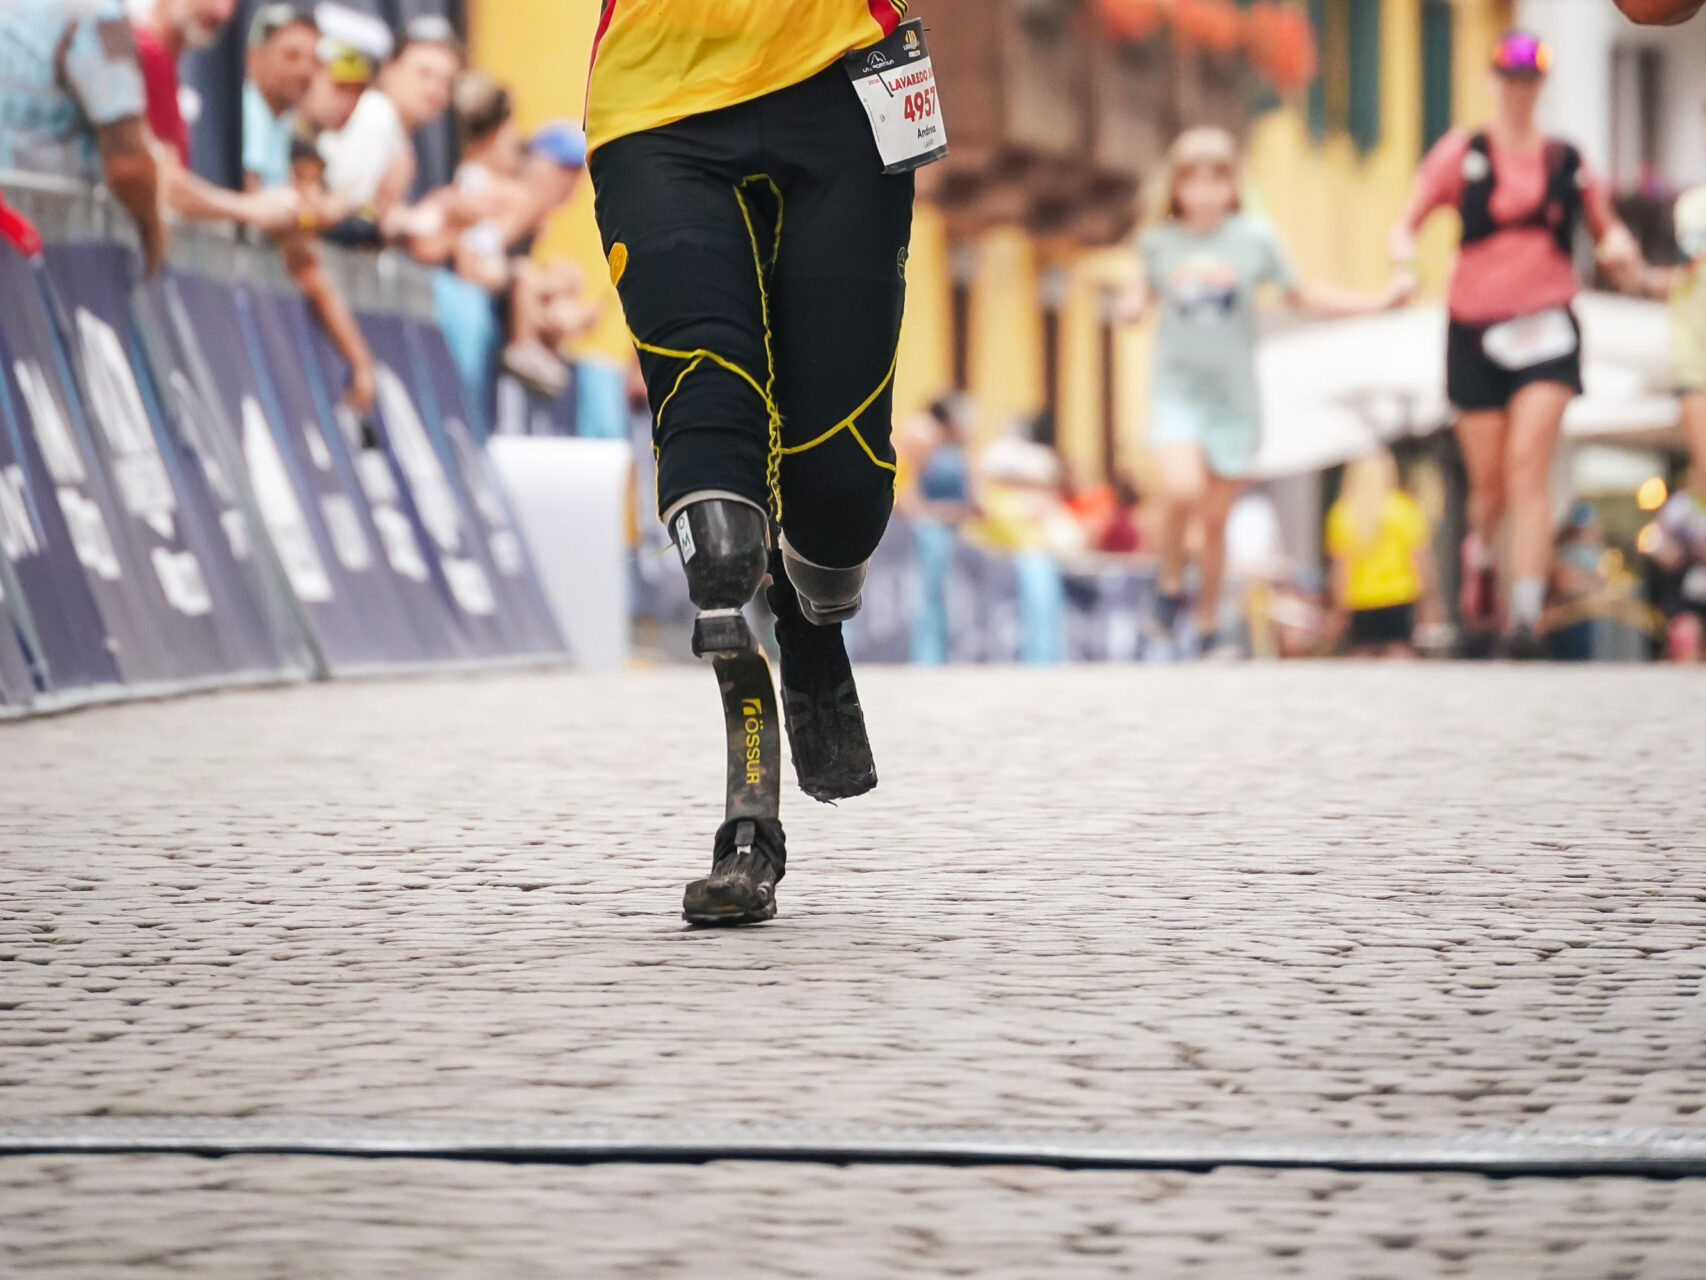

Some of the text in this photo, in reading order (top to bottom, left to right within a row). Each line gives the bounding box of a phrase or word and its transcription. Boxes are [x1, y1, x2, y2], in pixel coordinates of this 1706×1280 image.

[888, 69, 928, 92] LAVAREDO
[904, 85, 936, 122] 4957
[744, 717, 764, 785] ÖSSUR
